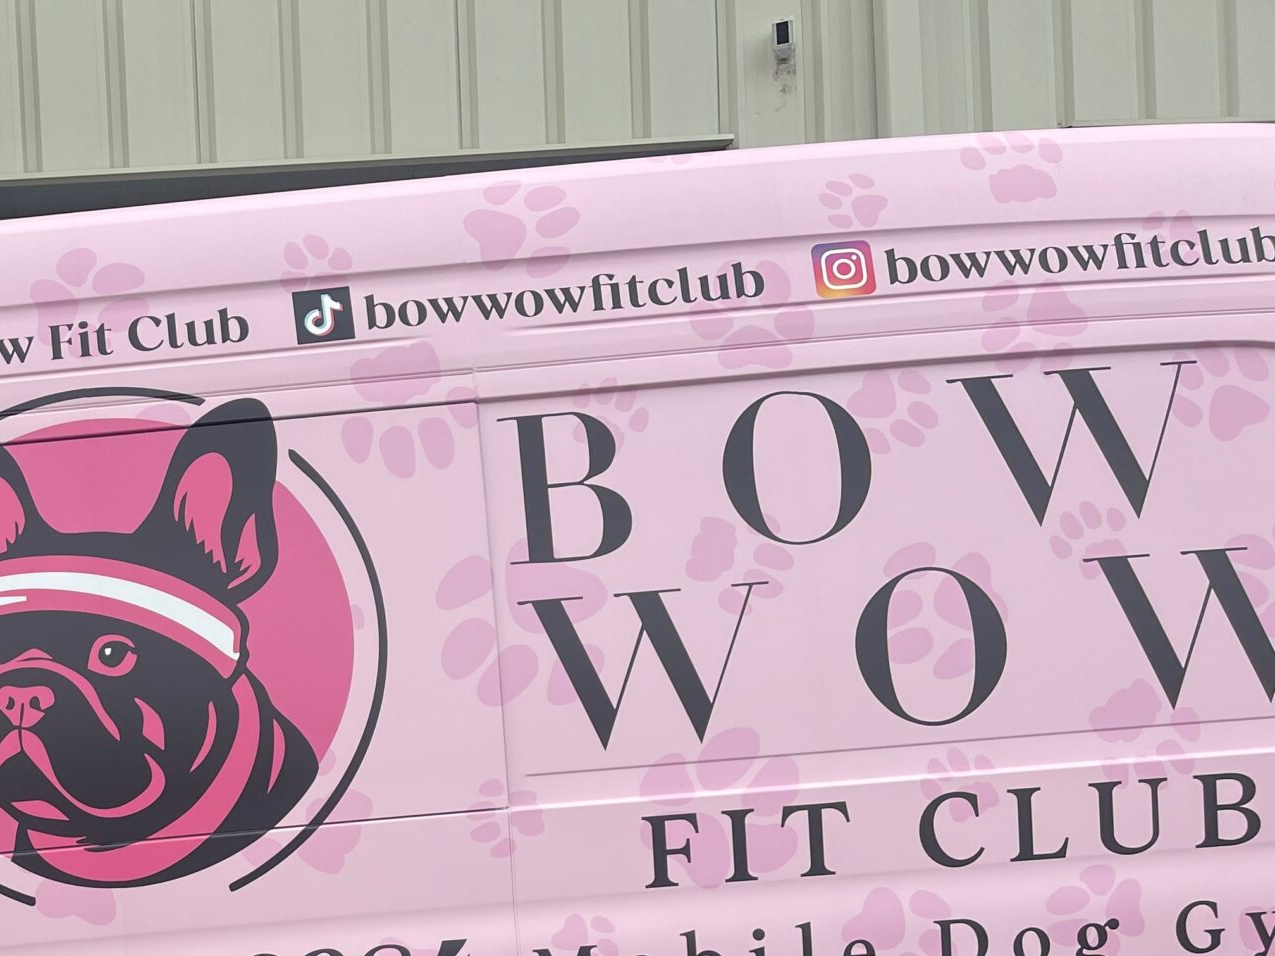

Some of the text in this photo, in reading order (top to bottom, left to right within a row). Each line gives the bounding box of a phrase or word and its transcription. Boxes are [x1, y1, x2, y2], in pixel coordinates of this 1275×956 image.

[364, 261, 765, 330] bowwowfitclub
[885, 226, 1275, 286] bowwowfitclub
[48, 320, 114, 360] Fit
[127, 308, 250, 352] Club
[496, 360, 1198, 566] BOW
[517, 547, 1275, 752] WOW
[641, 772, 1262, 889] FIT CLUB
